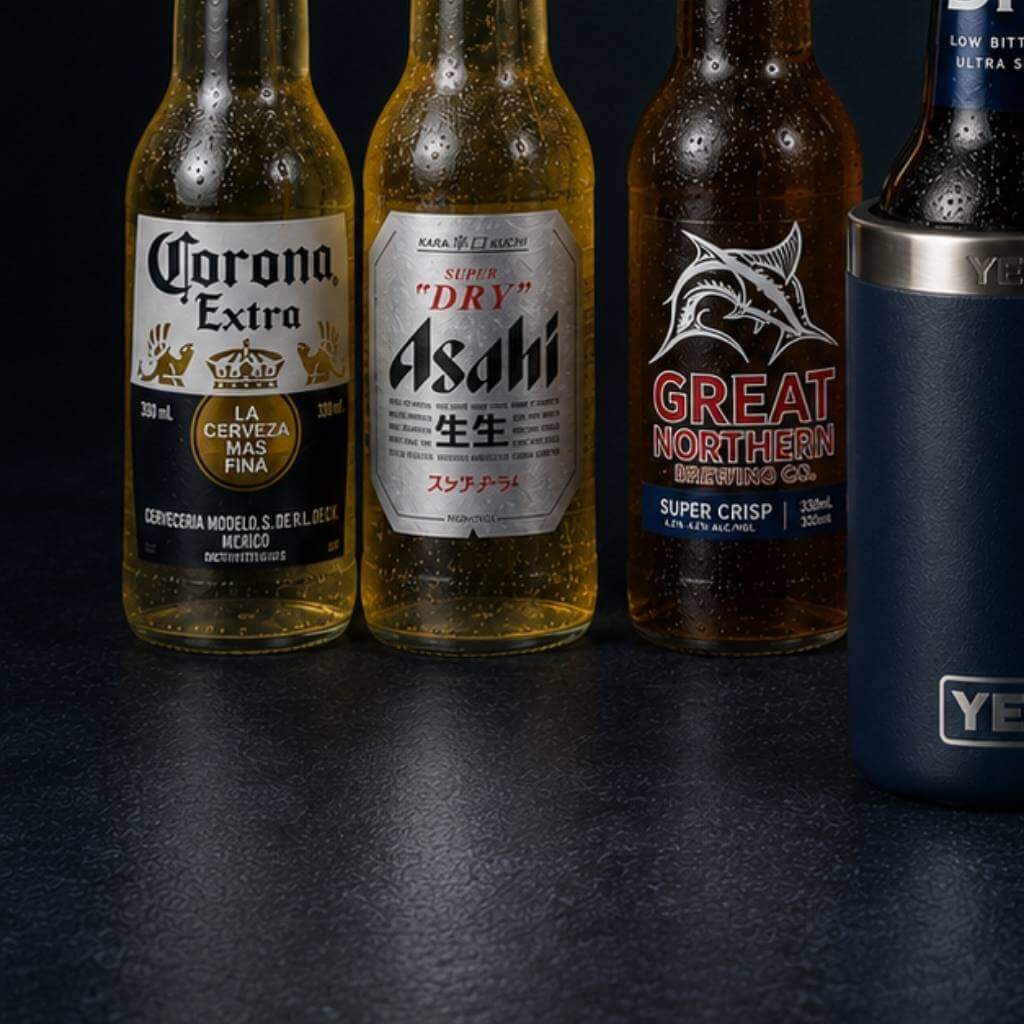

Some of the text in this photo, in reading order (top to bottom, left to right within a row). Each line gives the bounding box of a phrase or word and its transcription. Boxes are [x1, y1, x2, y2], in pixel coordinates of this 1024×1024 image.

[950, 34, 983, 48] LOW
[956, 56, 1006, 70] ULTRA
[147, 230, 333, 304] Corona
[195, 291, 302, 332] Extra
[389, 311, 560, 394] Asahi
[653, 366, 837, 427] GREAT
[234, 405, 260, 422] LA
[203, 422, 291, 439] CERVEZA
[435, 412, 510, 449] 生生
[226, 439, 268, 456] MAS
[652, 423, 836, 464] NORTHERN
[224, 457, 269, 474] FINA
[659, 498, 773, 521] SUPER CRISP
